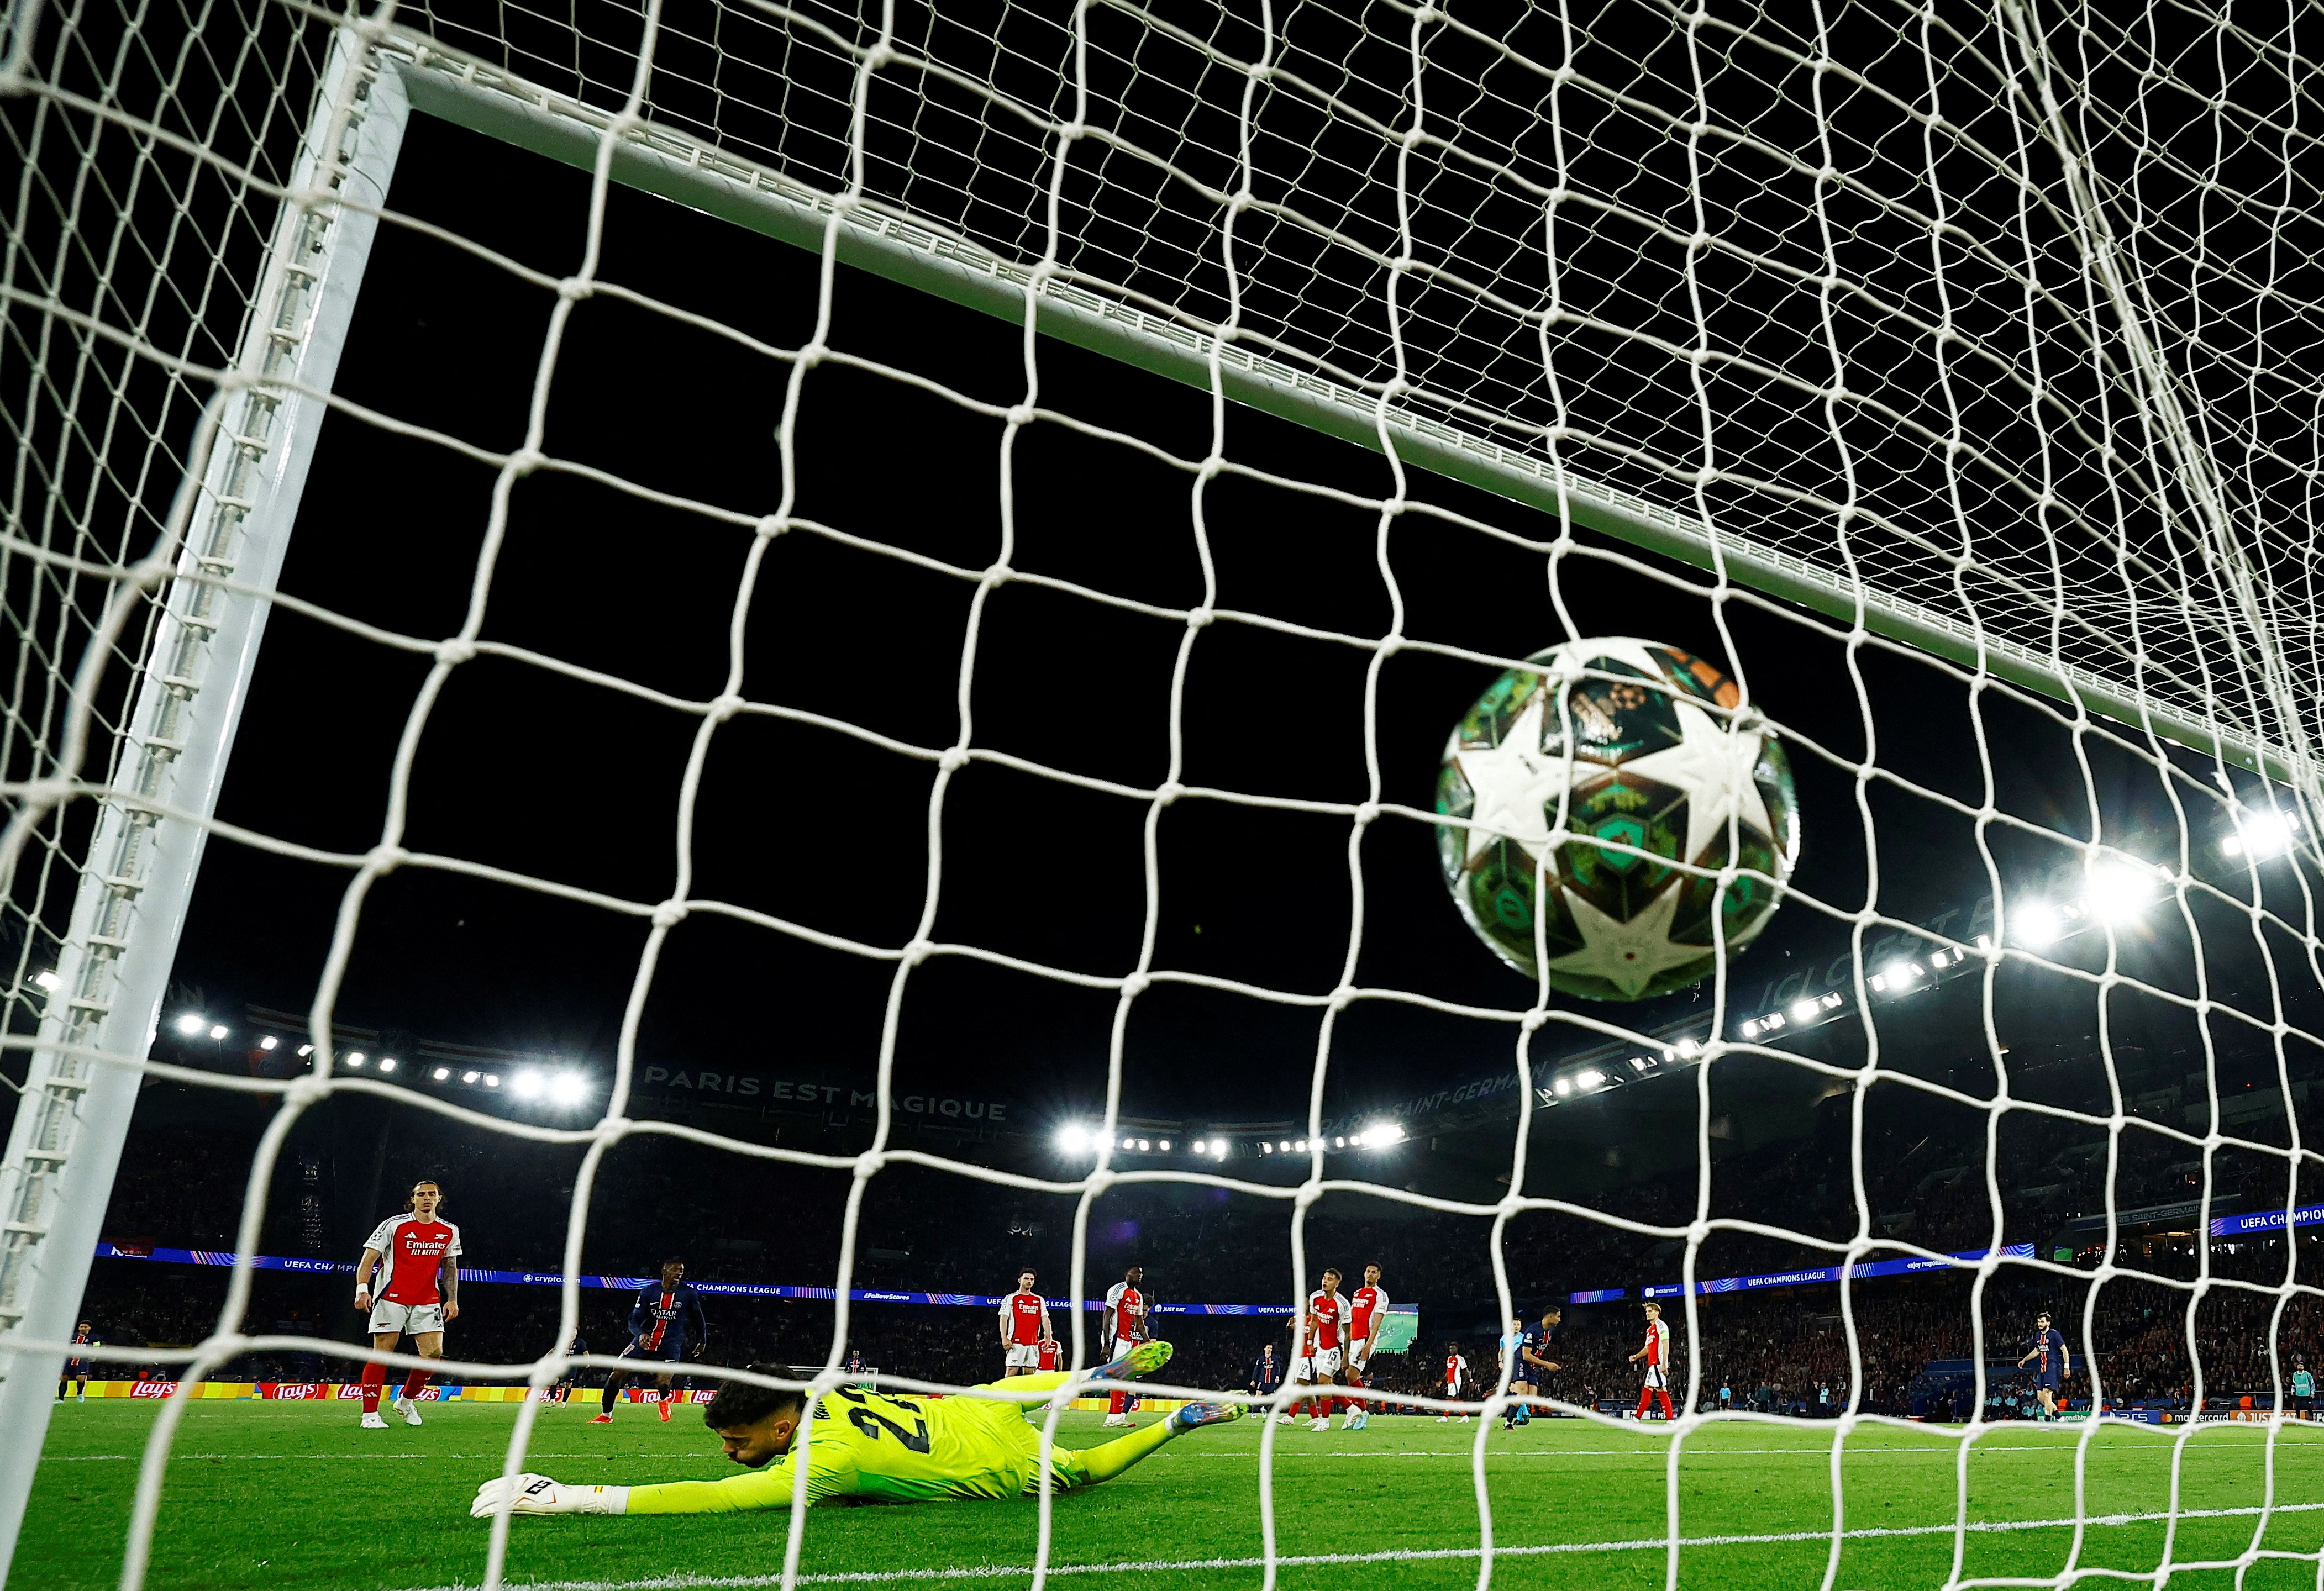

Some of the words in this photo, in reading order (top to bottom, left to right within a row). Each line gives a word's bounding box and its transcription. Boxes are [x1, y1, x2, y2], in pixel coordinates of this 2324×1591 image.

[644, 1066, 760, 1095] PARIS
[774, 1081, 840, 1104] EST
[2241, 1217, 2268, 1229] UEFA
[406, 1241, 446, 1249] Emirates
[284, 1260, 311, 1269] UEFA
[534, 1276, 580, 1284] crypto.cm
[1748, 1278, 1763, 1286] UEFA
[1764, 1274, 1800, 1284] CHAMPIONS
[1801, 1271, 1825, 1281] LEAGUE
[696, 1284, 747, 1293] CHAMPIONS
[1328, 1350, 1338, 1361] 15
[1299, 1363, 1308, 1373] 12
[132, 1381, 177, 1398] Lay's
[277, 1383, 315, 1400] Lay's
[2175, 1413, 2228, 1422] maercard
